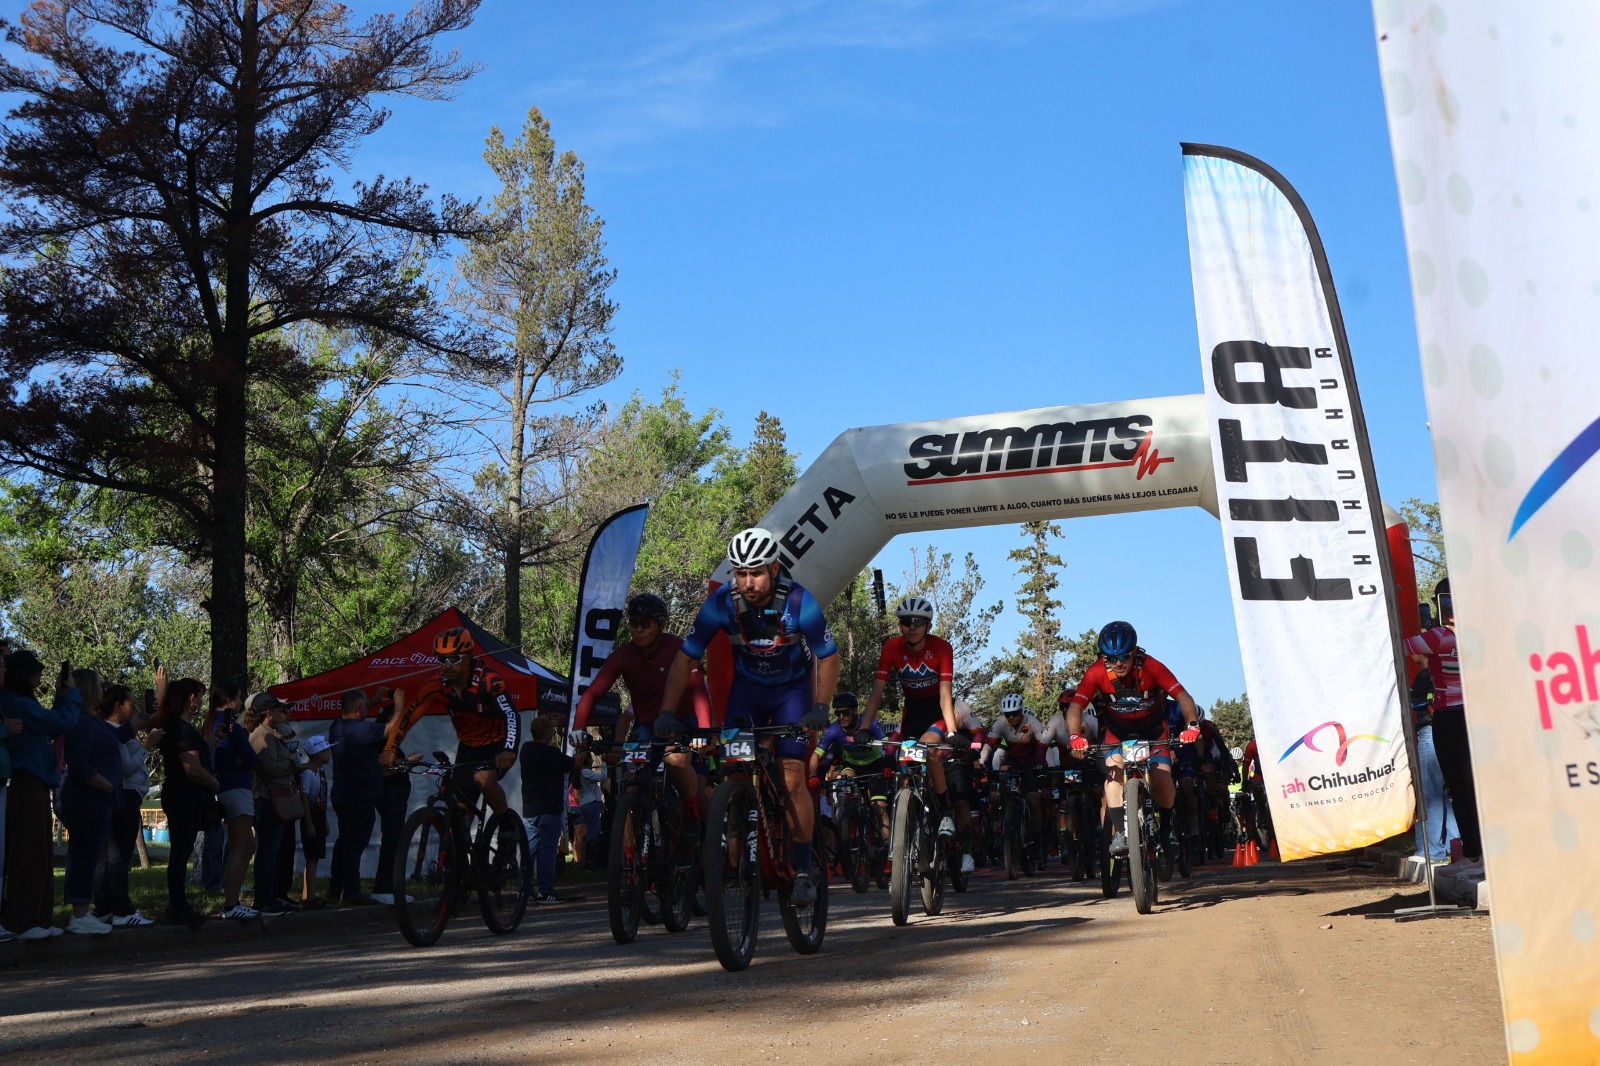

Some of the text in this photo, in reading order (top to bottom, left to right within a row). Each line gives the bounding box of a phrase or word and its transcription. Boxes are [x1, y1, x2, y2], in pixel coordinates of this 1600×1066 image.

[1315, 347, 1377, 595] CHIHUAHUA
[885, 513, 897, 521] NO
[898, 512, 908, 520] SE
[909, 511, 919, 519] LE
[920, 509, 945, 518] PUEDE
[946, 507, 972, 516] PONER
[1007, 502, 1030, 510] ALGO,
[1030, 499, 1062, 508] CUANTO
[1132, 490, 1157, 499] LEJOS
[1158, 485, 1199, 496] LLEGARÁS
[779, 486, 856, 578] ETA
[371, 656, 407, 665] RACE
[286, 701, 310, 712] ACE
[624, 751, 647, 763] 212
[724, 741, 752, 757] 164
[904, 749, 924, 758] 126
[1308, 759, 1396, 791] Chihuahua!
